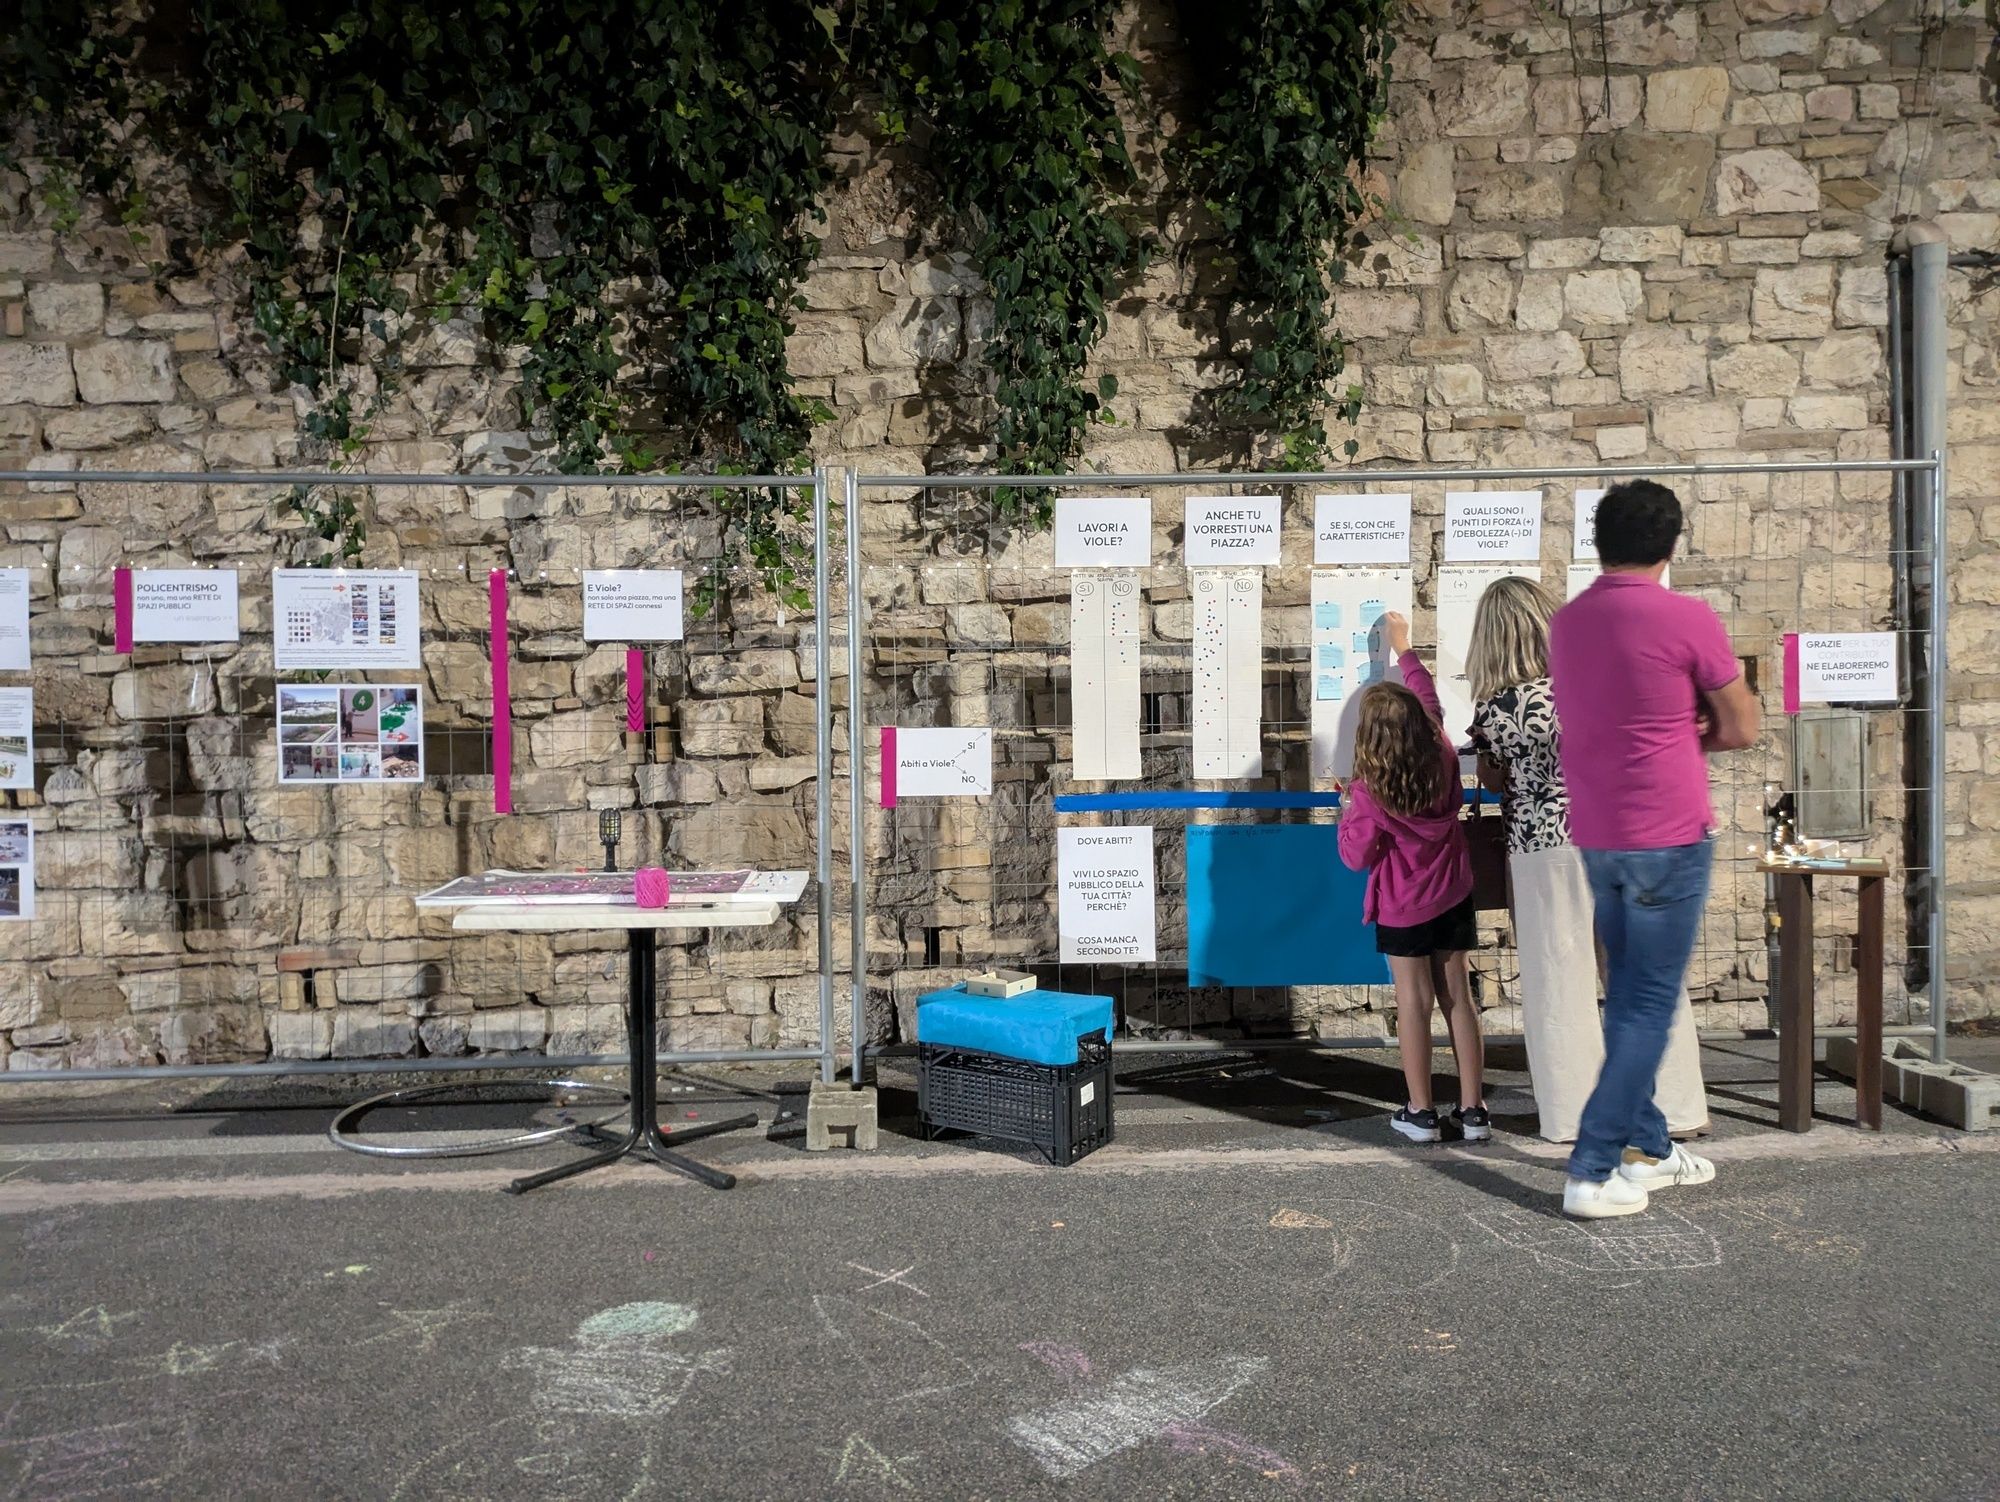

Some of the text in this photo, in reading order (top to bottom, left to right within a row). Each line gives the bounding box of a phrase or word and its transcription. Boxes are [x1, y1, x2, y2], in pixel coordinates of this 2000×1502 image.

[1205, 511, 1261, 520] ANCHE TU
[1463, 507, 1491, 515] QUALI
[1493, 507, 1519, 515] SONO
[1343, 522, 1353, 530] SI,
[1355, 521, 1375, 529] CON
[1481, 518, 1491, 526] DI
[1493, 518, 1522, 526] FORZA
[1523, 518, 1534, 526] (+)
[1078, 523, 1128, 532] LAVORI A
[1193, 524, 1273, 534] VORRESTI UNA
[1320, 532, 1404, 540] CARATTERISTICHE?
[1453, 529, 1510, 538] /DEBOLEZZA
[1522, 529, 1532, 537] DI
[1084, 537, 1122, 546] VIOLE?
[1211, 538, 1254, 547] PIAZZA?
[1477, 540, 1508, 548] VIOLE?
[136, 584, 218, 592] POLICENTRISMO
[588, 583, 622, 592] E Viole?
[1115, 583, 1129, 593] NO
[1237, 582, 1251, 590] NO
[1806, 640, 1842, 648] GRAZIE
[1871, 639, 1889, 647] TUO
[1821, 661, 1889, 670] ELABOREREMO
[1822, 672, 1875, 681] UN REPORT!
[359, 695, 366, 705] 4
[967, 742, 976, 750] SI
[900, 760, 921, 768] Abiti
[929, 759, 956, 768] Viole?
[961, 775, 976, 783] NO
[1077, 837, 1133, 845] DOVE ABITI?
[1073, 869, 1139, 878] VIVI LO SPAZIO
[1069, 881, 1144, 889] PUBBLICO DELLA
[1082, 890, 1132, 900] TUA CITTÀ?
[1078, 936, 1138, 944] COSA MANCA
[1077, 947, 1139, 956] SECONDO TE?
